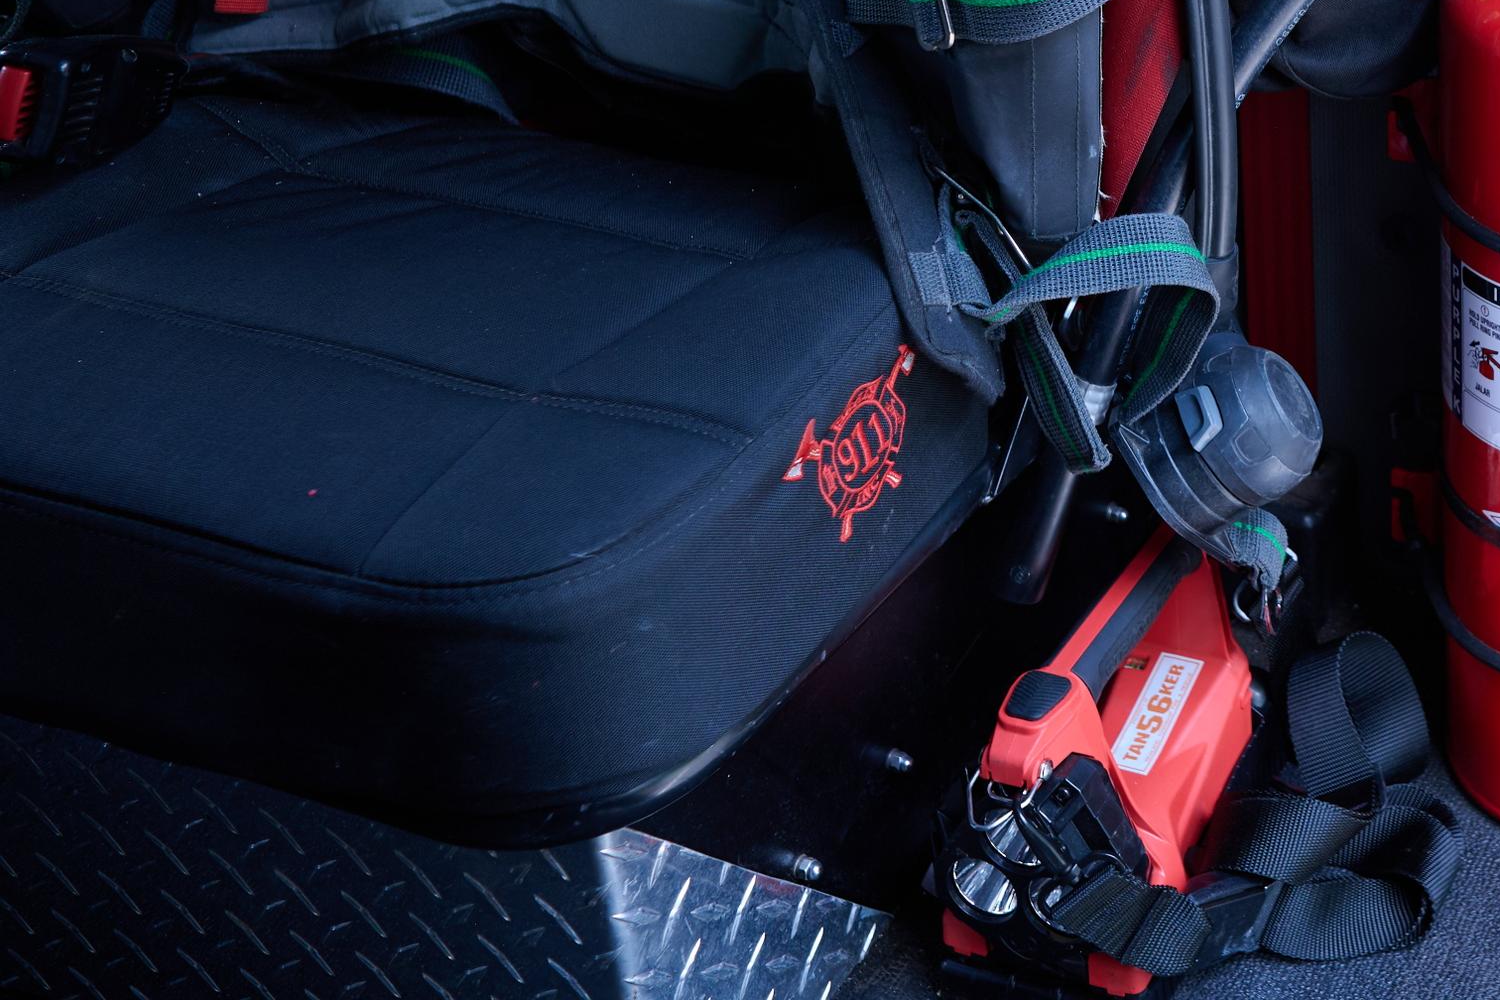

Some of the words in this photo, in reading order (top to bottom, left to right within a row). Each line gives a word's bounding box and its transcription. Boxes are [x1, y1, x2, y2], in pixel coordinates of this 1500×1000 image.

[1451, 263, 1460, 385] PURPLE
[1480, 324, 1491, 337] RING
[1453, 396, 1461, 415] K
[1475, 382, 1491, 398] JALAR
[837, 412, 891, 482] 911
[1122, 664, 1185, 761] TAN56KER
